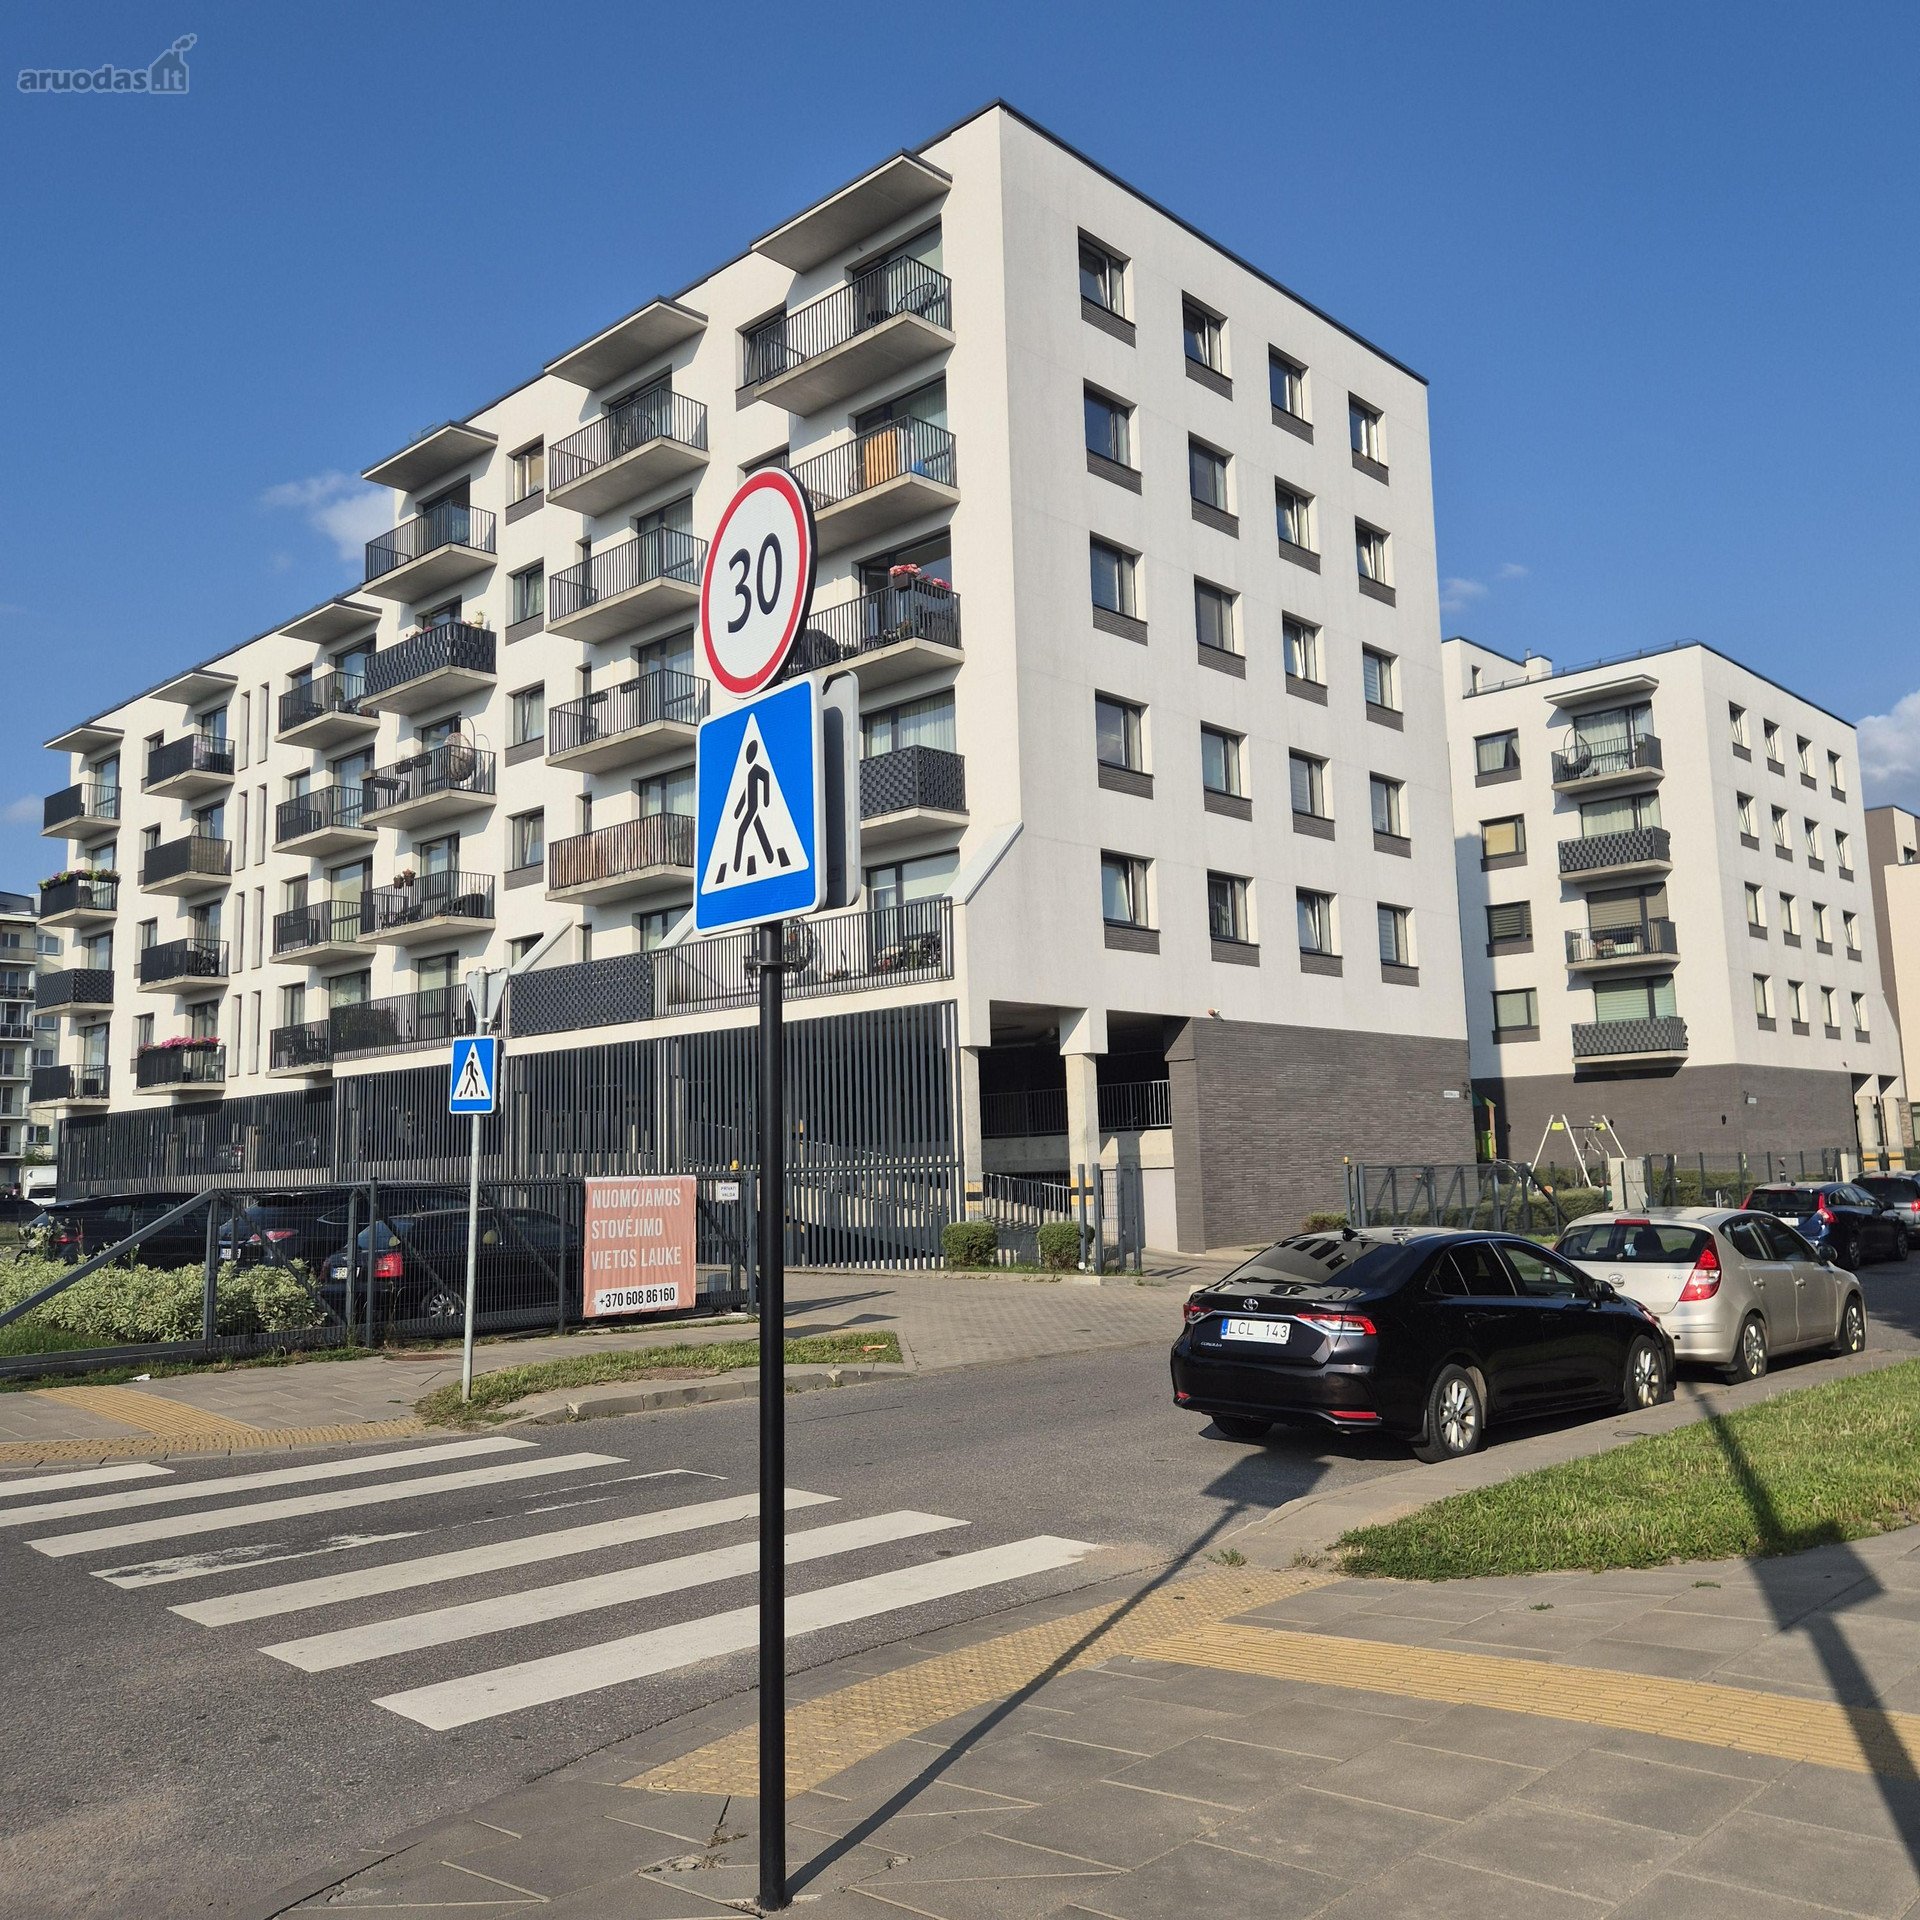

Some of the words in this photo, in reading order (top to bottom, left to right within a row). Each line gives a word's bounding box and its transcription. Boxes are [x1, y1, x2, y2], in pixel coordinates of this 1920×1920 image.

[727, 532, 783, 633] 30
[592, 1188, 681, 1209] NUOMOJAMOS
[591, 1215, 663, 1240] STOVĖJIMO
[591, 1248, 637, 1270] VIETOS
[640, 1246, 682, 1267] LAUKE
[599, 1292, 624, 1308] +370
[626, 1290, 644, 1306] 608
[1228, 1321, 1254, 1335] LCL
[1266, 1323, 1288, 1338] 143
